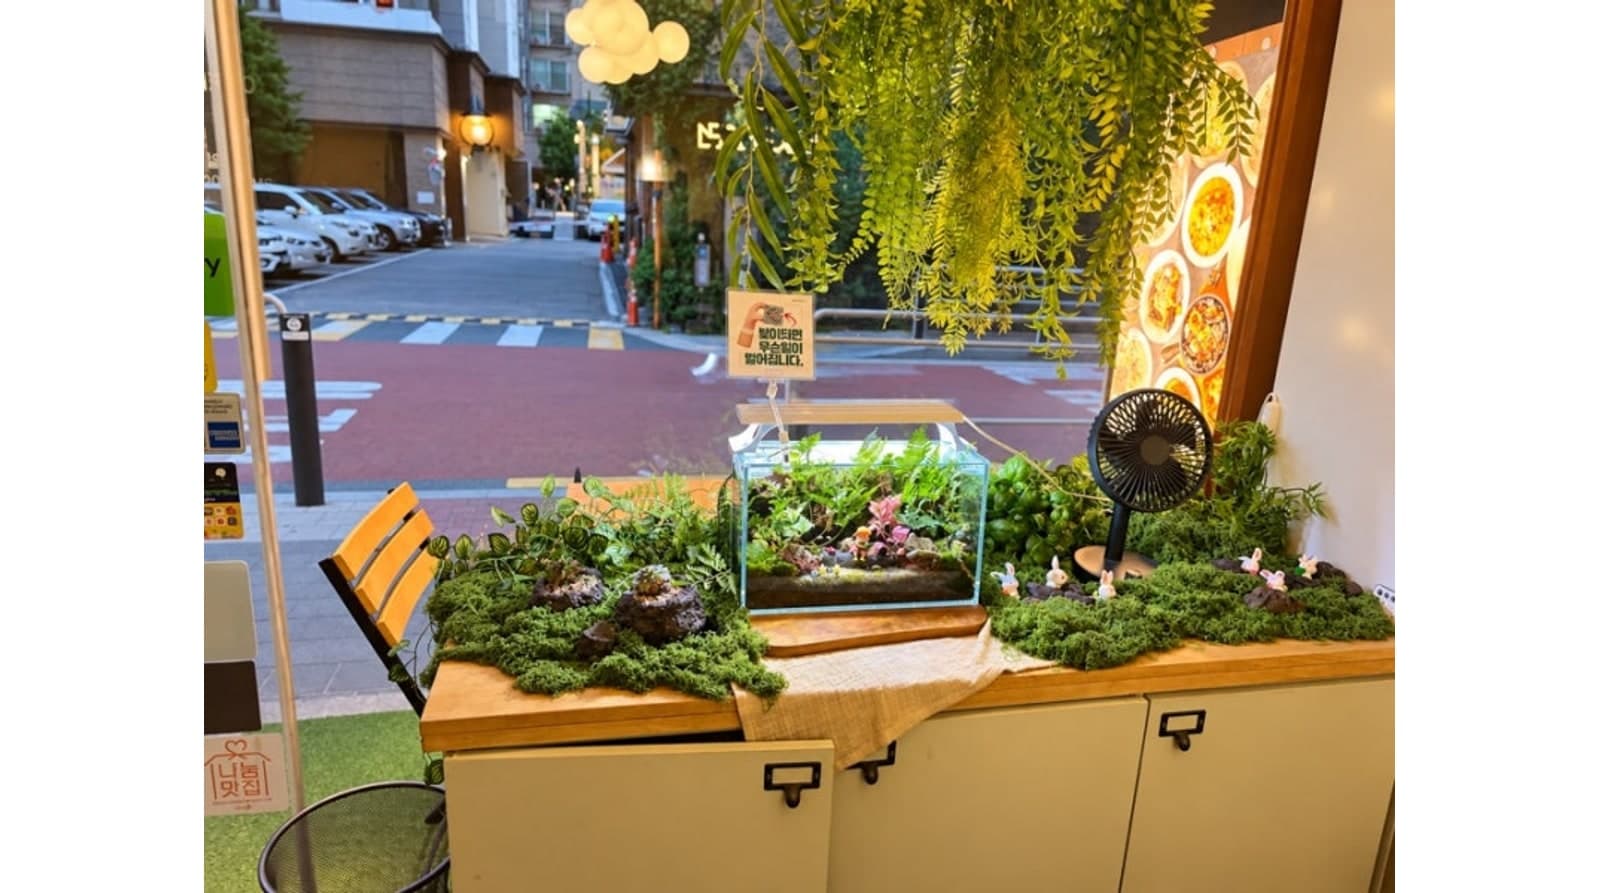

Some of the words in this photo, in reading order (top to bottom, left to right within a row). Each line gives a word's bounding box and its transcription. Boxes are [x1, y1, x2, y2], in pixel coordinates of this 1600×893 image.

[745, 353, 804, 367] 벌어집니다.
[218, 762, 259, 778] 나눔
[220, 779, 260, 798] 맛집
